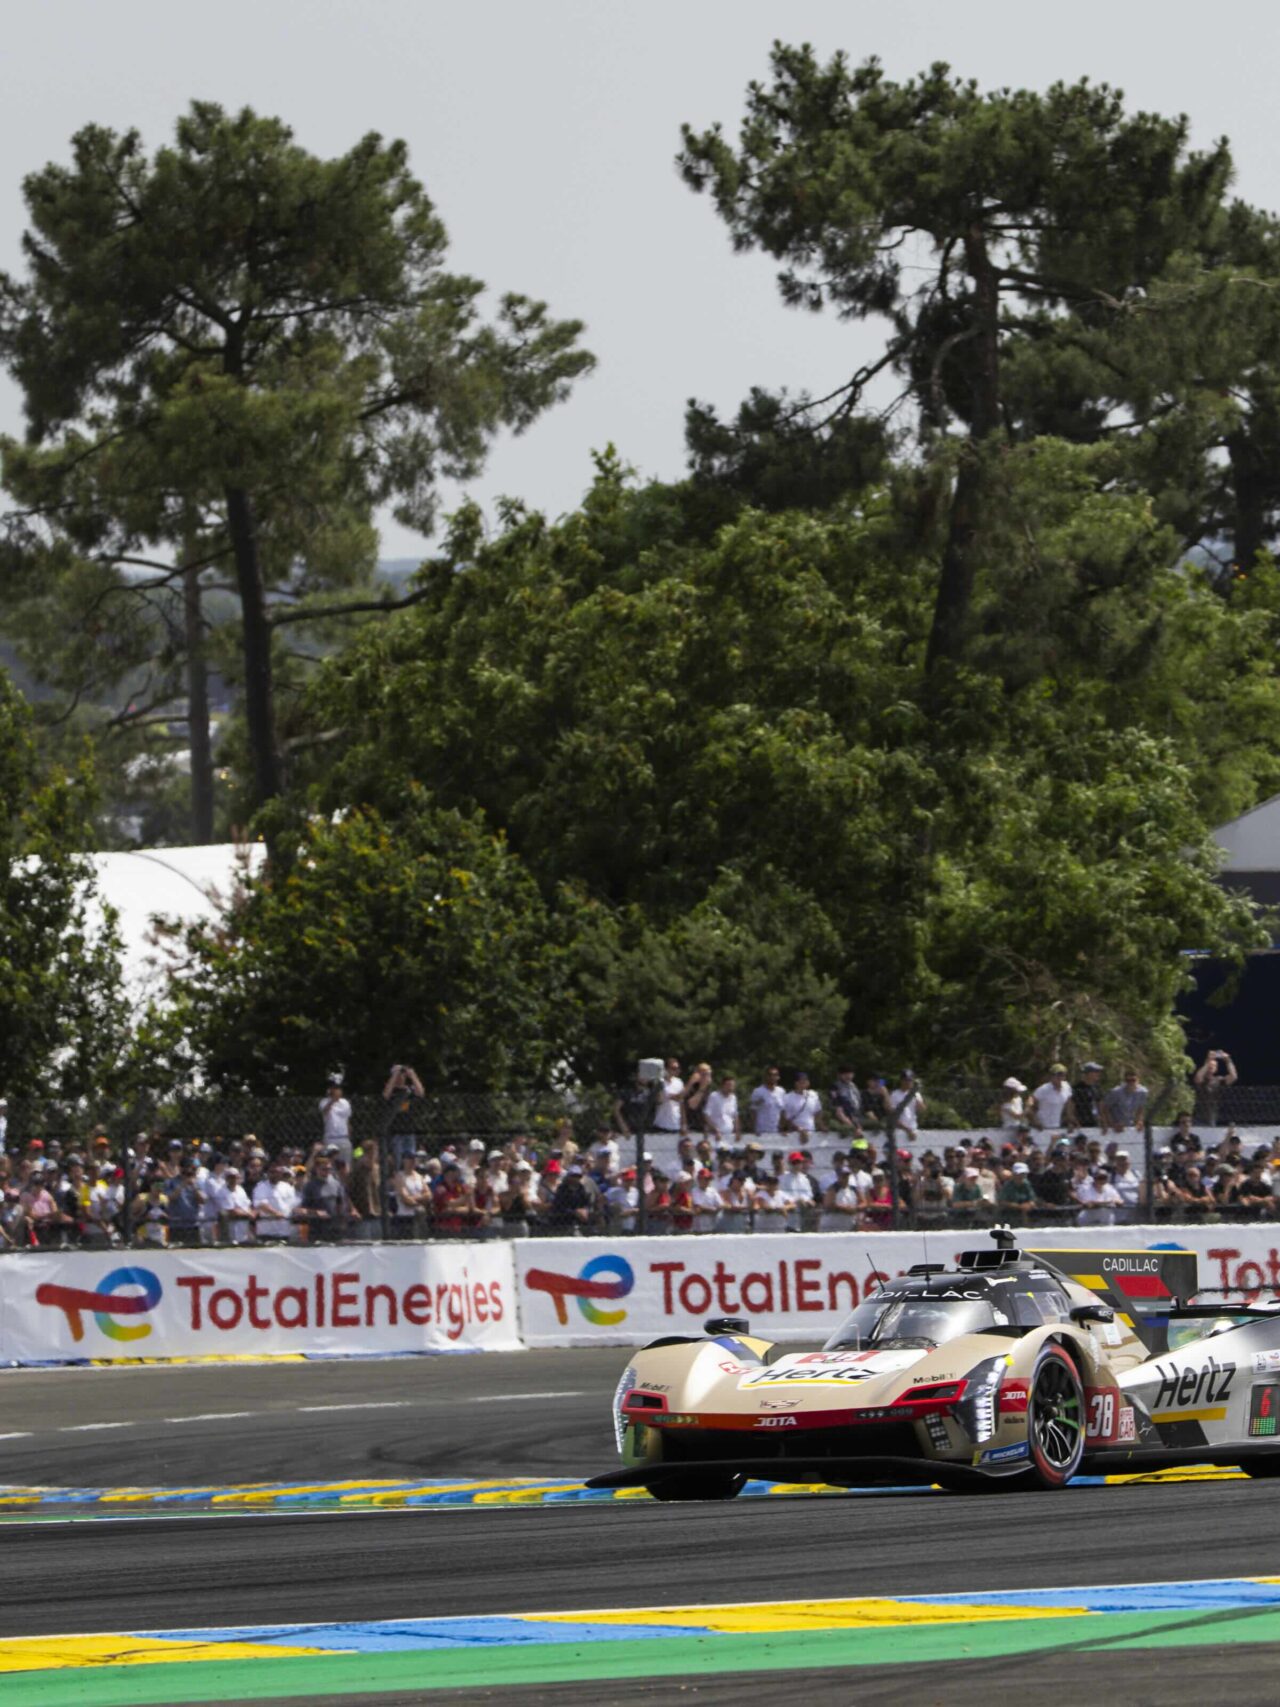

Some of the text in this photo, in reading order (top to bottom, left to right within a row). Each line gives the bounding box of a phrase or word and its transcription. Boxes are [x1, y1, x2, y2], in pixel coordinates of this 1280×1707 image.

[1102, 1258, 1159, 1272] CADILLAC
[176, 1267, 504, 1340] TotalEnergies
[750, 1366, 885, 1384] Hertz
[913, 1373, 946, 1385] Mobil
[1153, 1355, 1237, 1409] Hertz
[1002, 1391, 1027, 1400] JOTA
[753, 1416, 798, 1428] JOTA
[1087, 1394, 1114, 1437] 38
